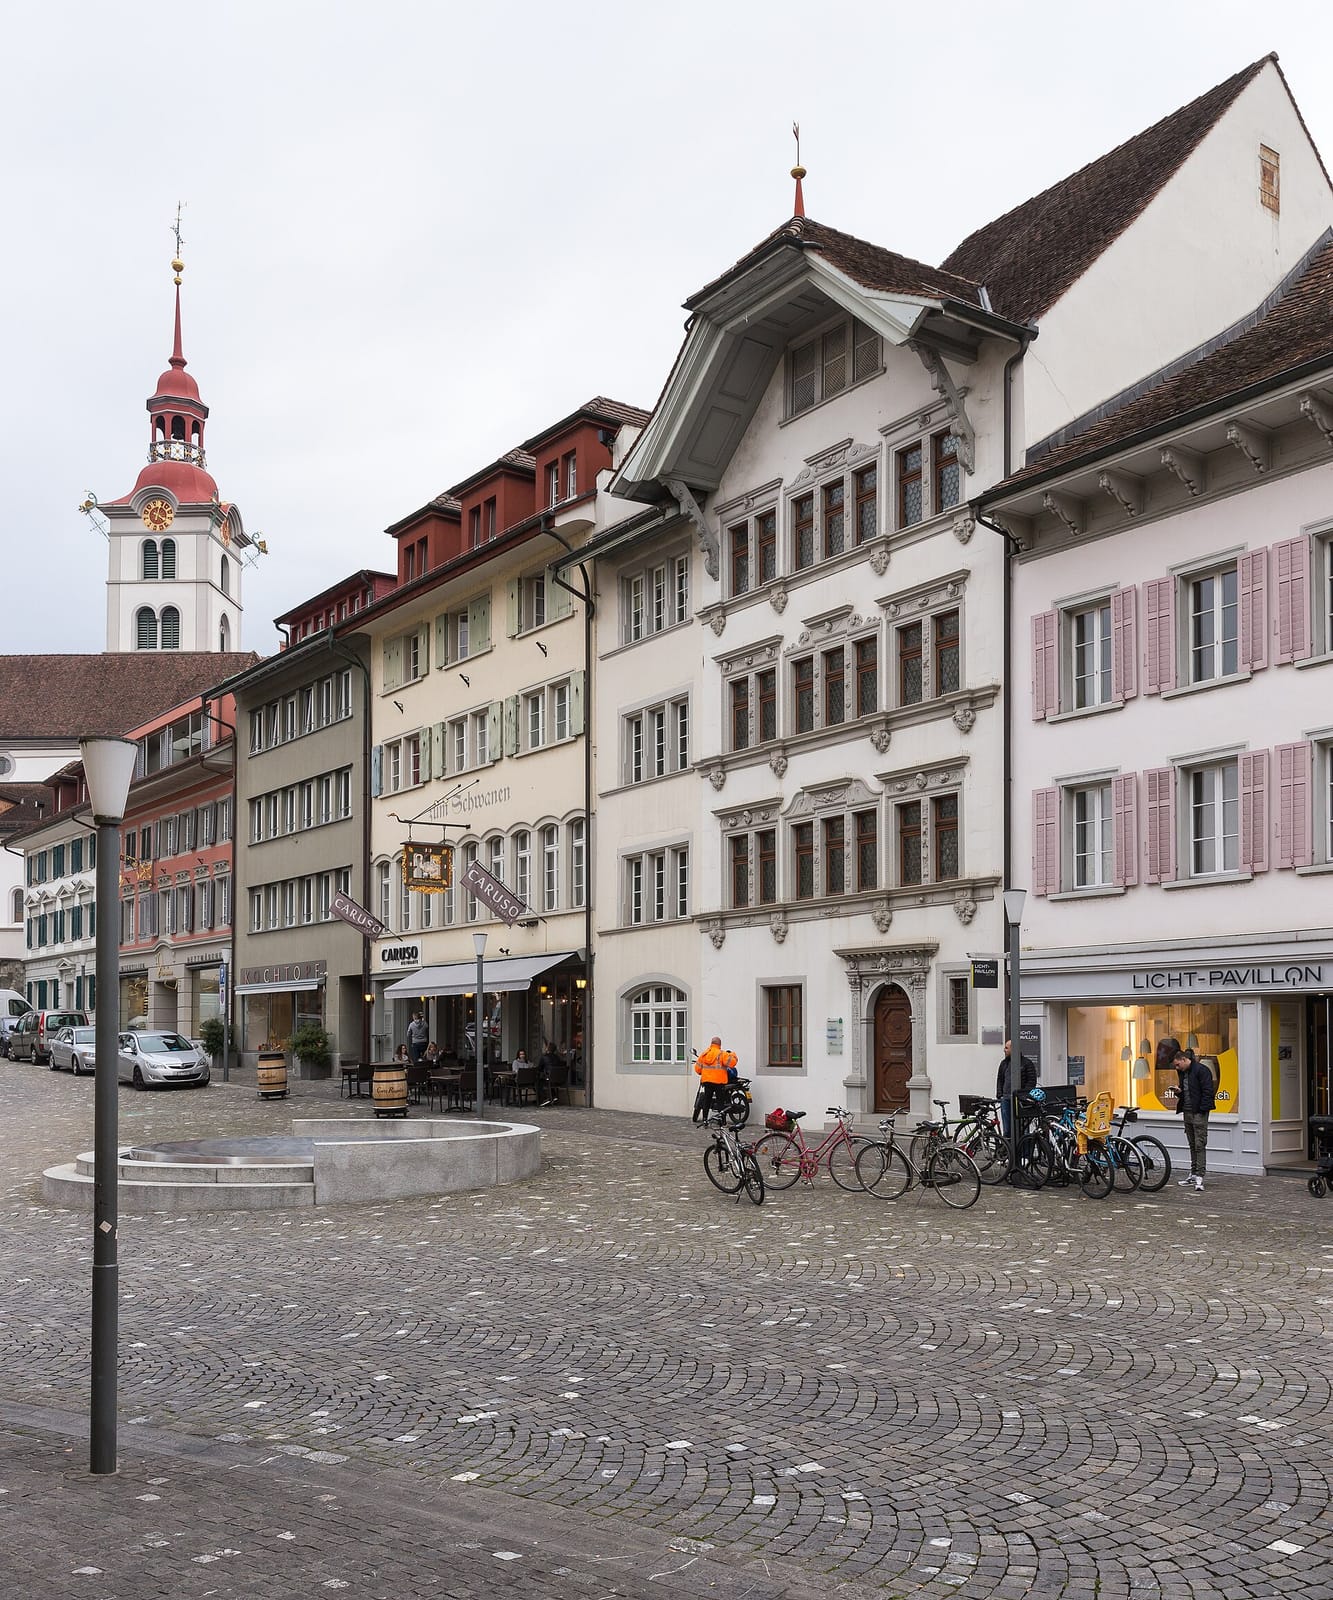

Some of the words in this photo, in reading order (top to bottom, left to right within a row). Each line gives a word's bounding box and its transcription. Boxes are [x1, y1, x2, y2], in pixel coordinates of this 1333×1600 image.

[452, 786, 511, 816] Schwanen
[468, 869, 519, 918] CARUSO
[335, 898, 382, 933] CARUSO
[381, 945, 419, 962] CARUSO
[244, 963, 320, 985] KOCHTOPF
[1132, 965, 1322, 990] LICHT-PAVILLON
